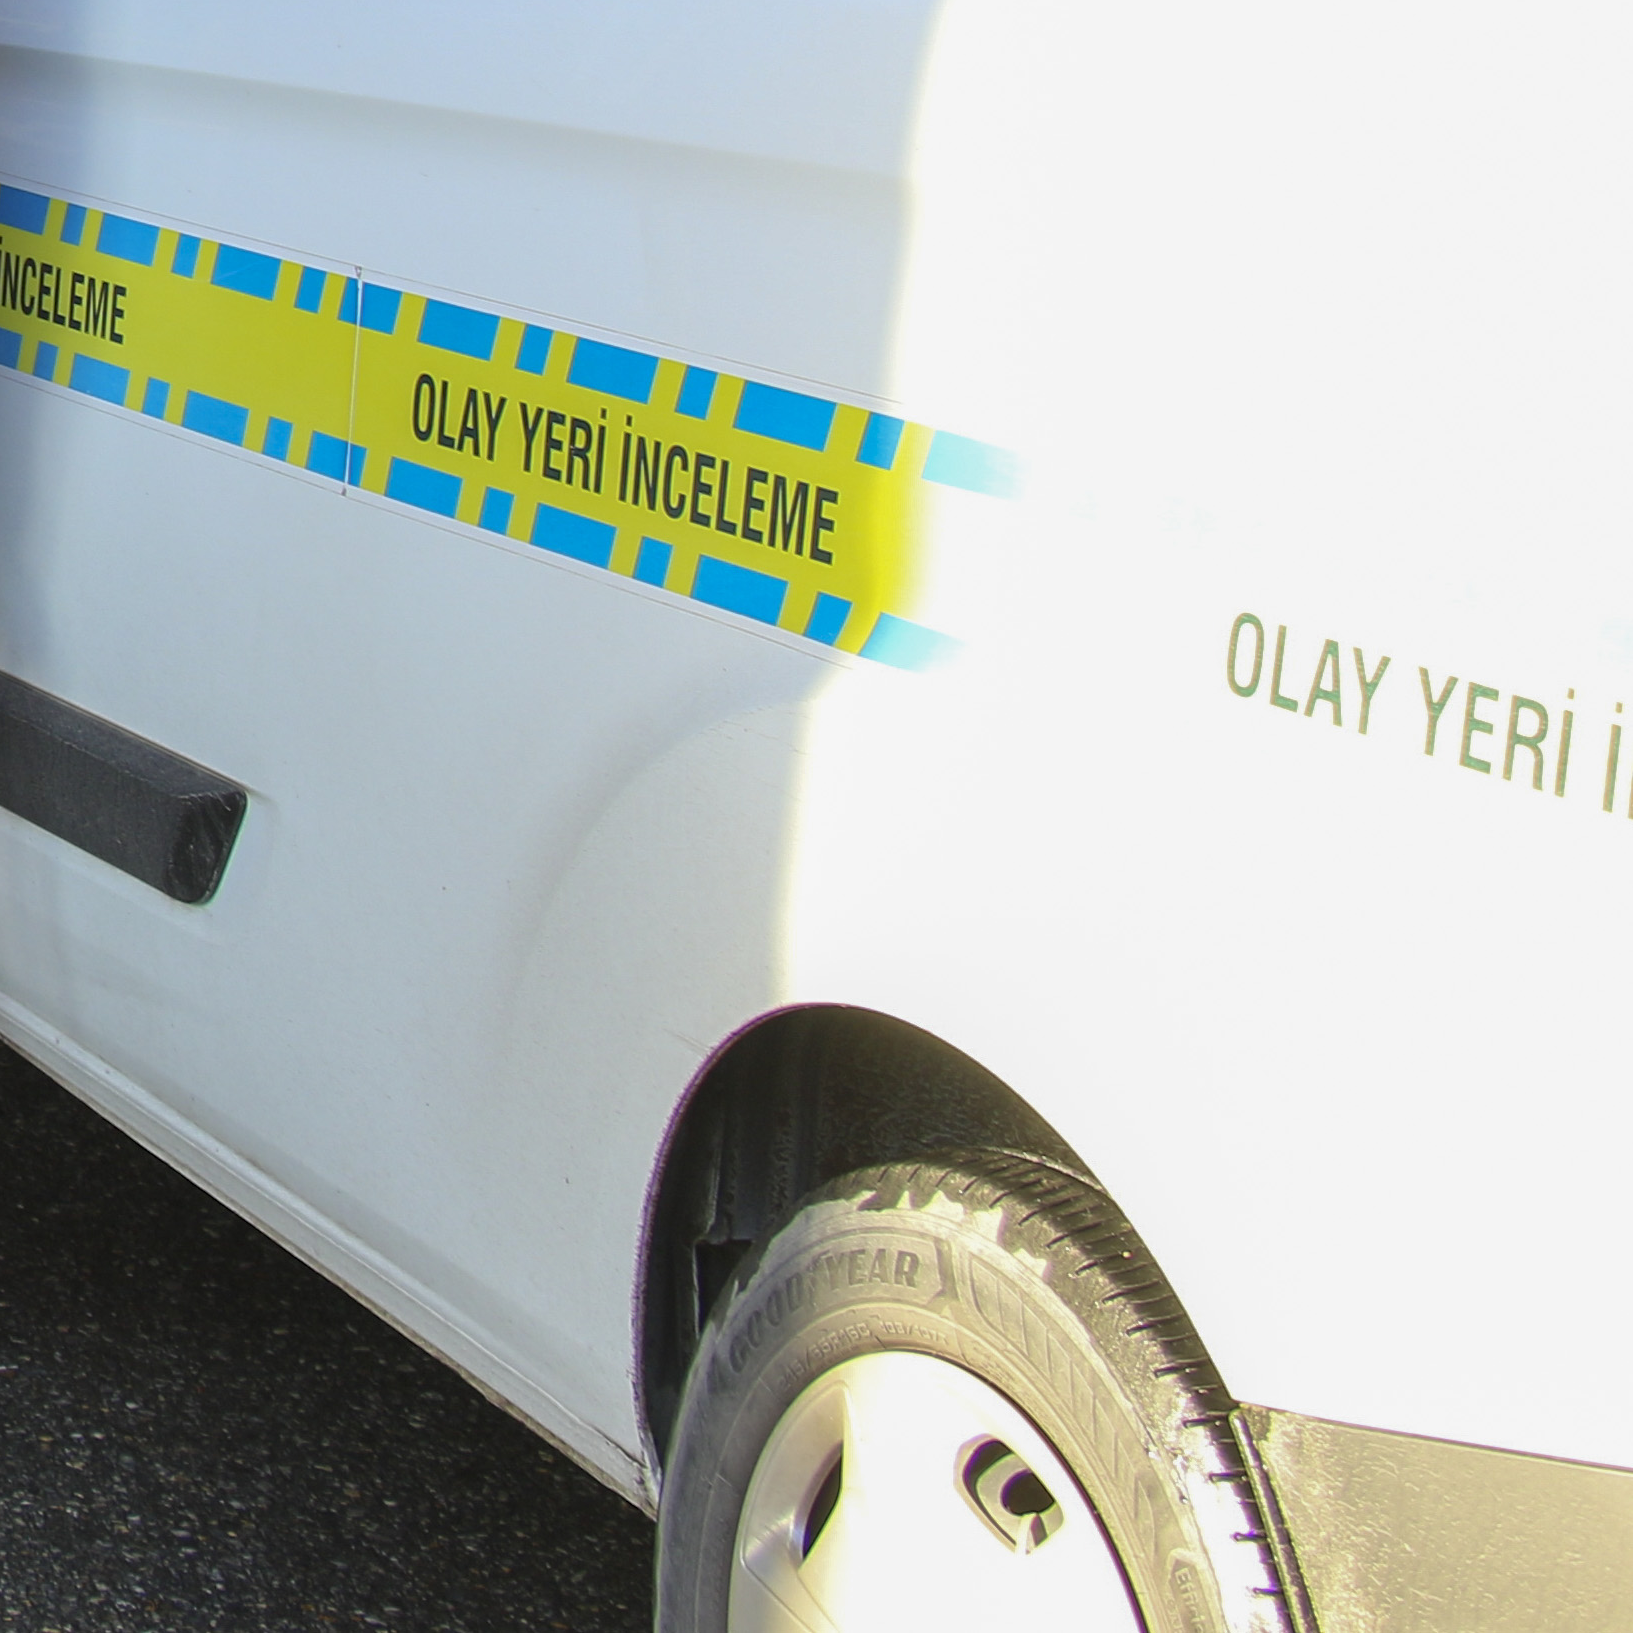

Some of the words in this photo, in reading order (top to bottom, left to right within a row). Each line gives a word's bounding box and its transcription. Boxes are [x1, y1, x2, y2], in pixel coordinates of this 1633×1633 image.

[411, 372, 507, 462] OLAY
[519, 407, 607, 496] YERİ
[618, 415, 839, 566] İNCELEME
[1226, 611, 1392, 736] OLAY
[1418, 687, 1575, 798] YERİ
[1602, 701, 1633, 821] İ
[729, 1248, 921, 1374] GOODYEAR
